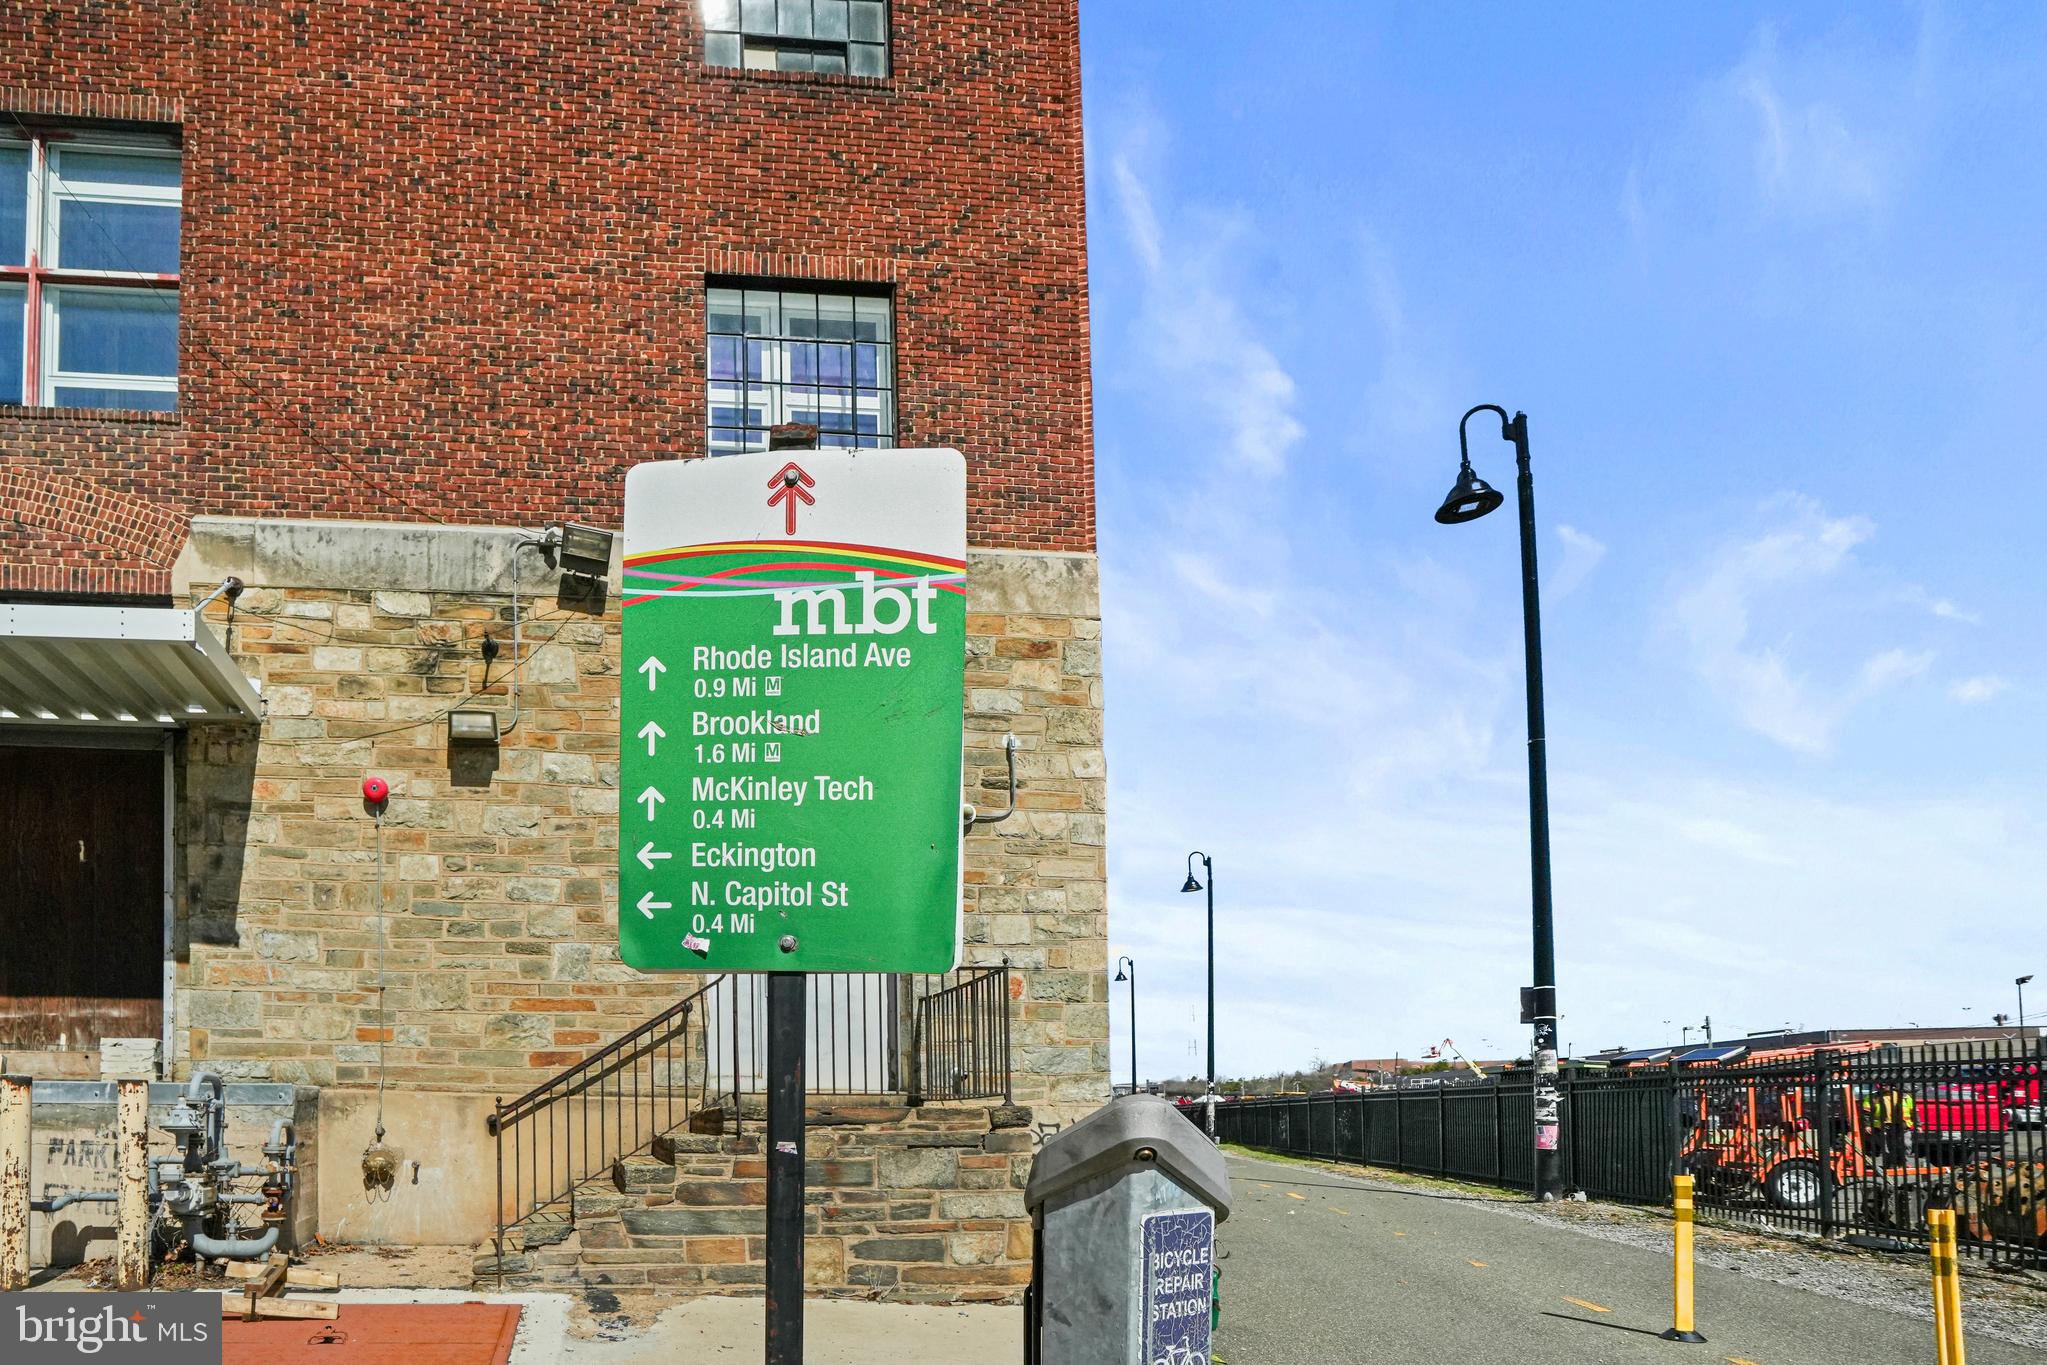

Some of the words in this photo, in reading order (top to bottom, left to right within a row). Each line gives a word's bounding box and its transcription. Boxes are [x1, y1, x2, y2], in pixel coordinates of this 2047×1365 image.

[773, 571, 938, 635] mbt
[694, 645, 772, 671] Rhode
[782, 643, 857, 669] Island
[864, 643, 911, 668] Ave
[694, 678, 725, 698] 0.9
[733, 677, 756, 697] Mi
[693, 709, 820, 736] Brookland
[695, 744, 725, 764] 1.6
[733, 743, 756, 763] Mi
[693, 776, 808, 805] McKinley
[814, 775, 874, 801] Tech
[693, 810, 724, 830] 0.4
[732, 809, 756, 829] Mi
[692, 842, 816, 872] Eckington
[692, 882, 716, 906] N.
[725, 881, 813, 911] Capitol
[821, 882, 849, 906] St
[693, 914, 724, 933] 0.4
[731, 914, 755, 933] Mi
[1154, 1247, 1209, 1270] BICYCLE
[1155, 1273, 1205, 1296] REPAIR
[1153, 1297, 1207, 1322] STATION
